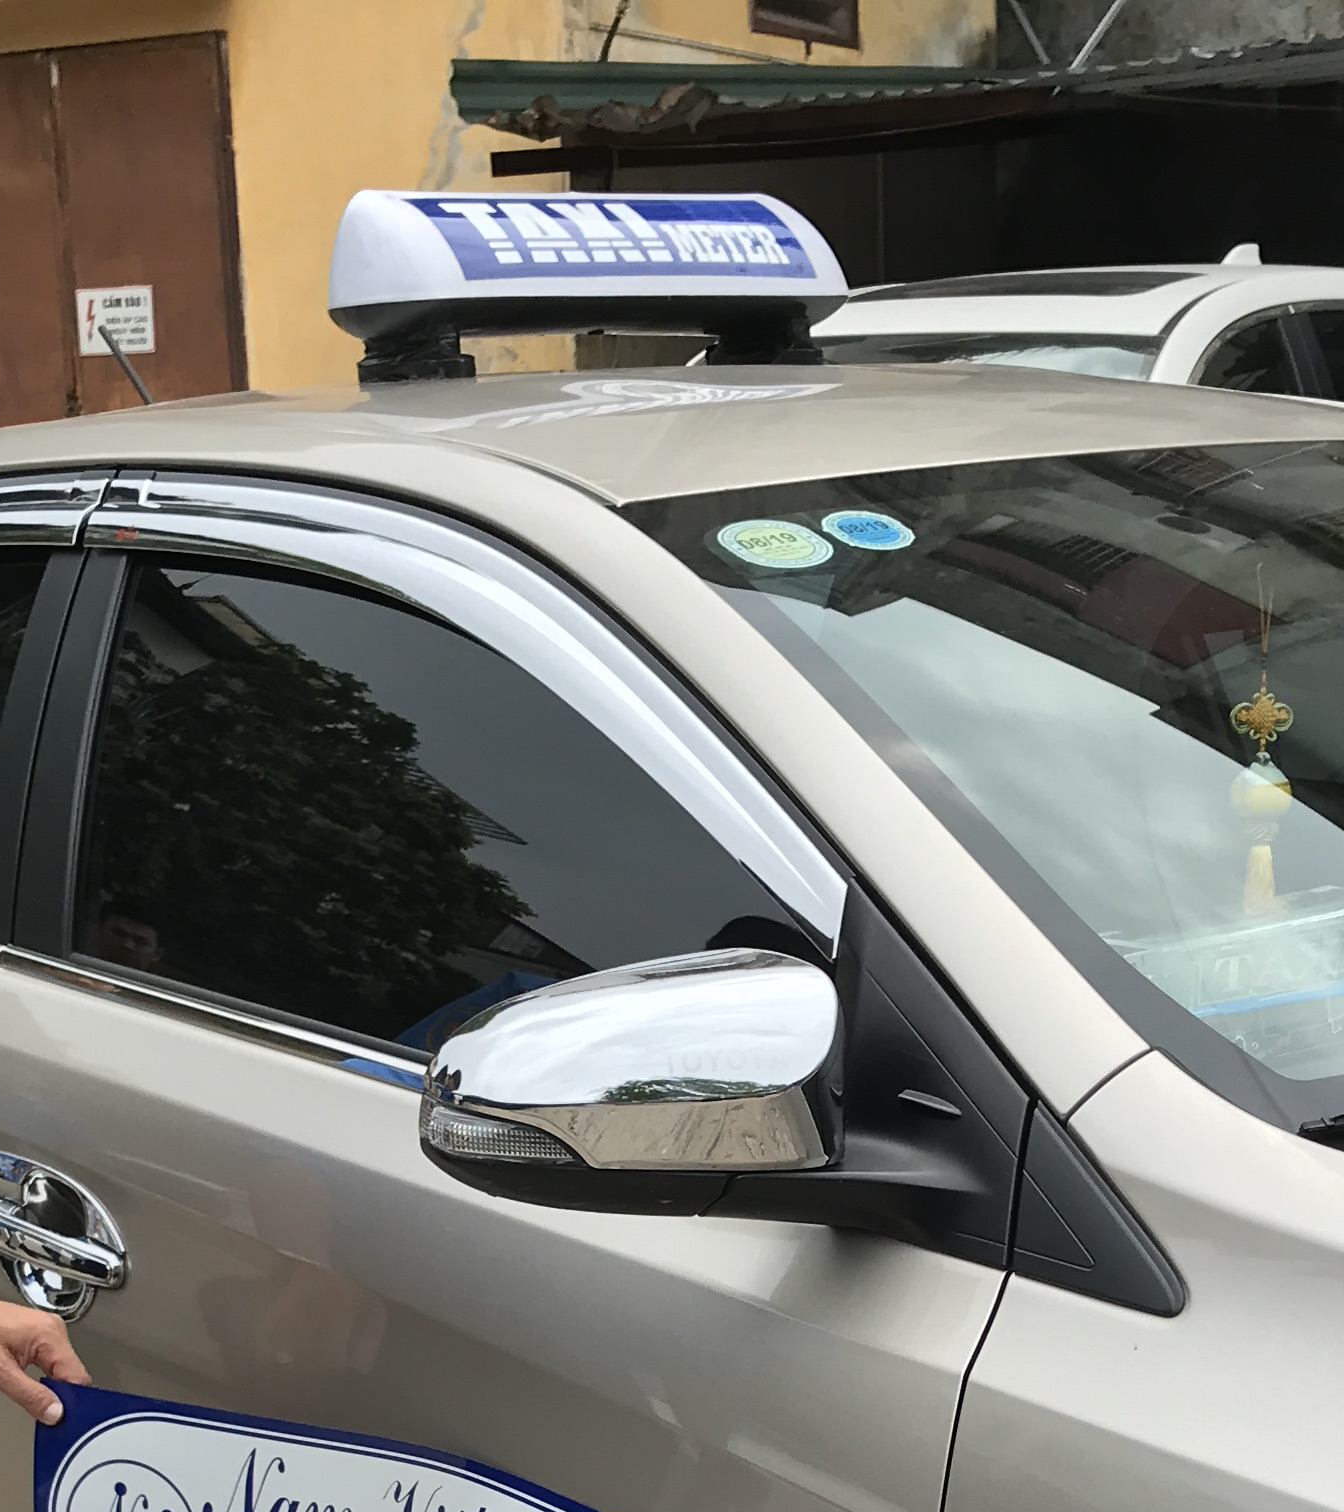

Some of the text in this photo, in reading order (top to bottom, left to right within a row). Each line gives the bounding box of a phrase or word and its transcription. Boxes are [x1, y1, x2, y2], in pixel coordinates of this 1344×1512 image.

[438, 202, 791, 264] TAXI METER
[838, 520, 890, 535] 08/19
[737, 532, 798, 549] 08/19
